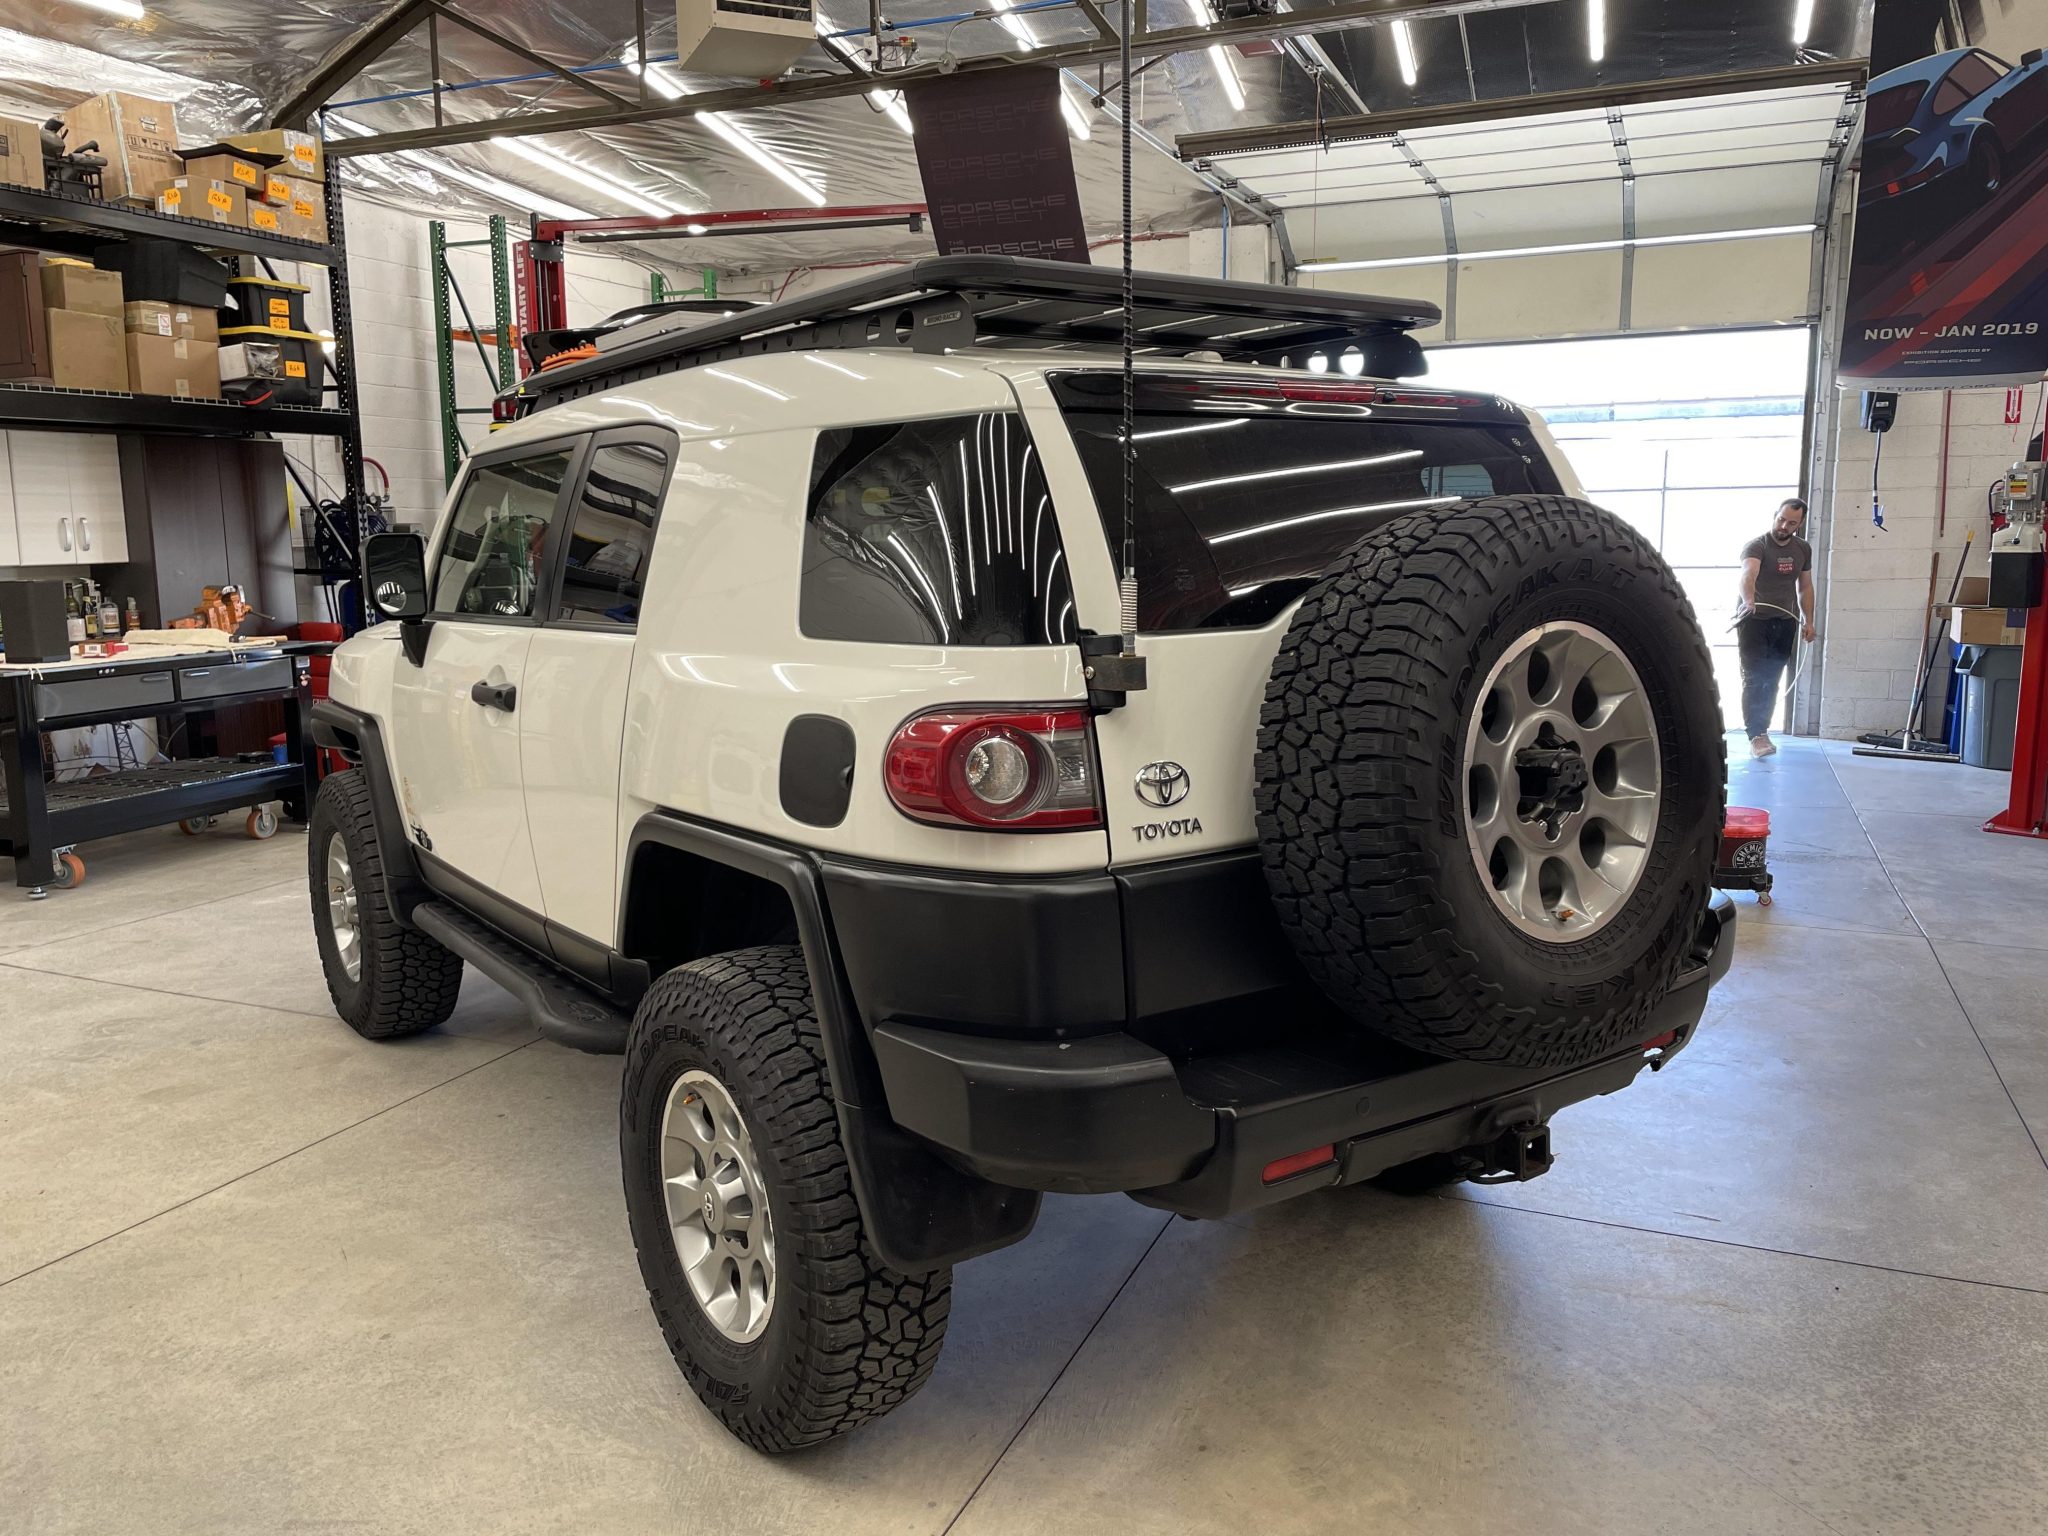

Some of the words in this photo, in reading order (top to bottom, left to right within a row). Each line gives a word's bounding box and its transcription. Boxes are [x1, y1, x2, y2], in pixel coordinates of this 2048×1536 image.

[923, 102, 1049, 124] PORSCHE
[924, 117, 1028, 138] EFFECT
[931, 149, 1057, 170] PORSCHE
[933, 165, 1037, 184] EFFECT
[940, 195, 1067, 216] PORSCHE
[942, 210, 1049, 229] EFFECT
[515, 243, 526, 279] LIFT
[1864, 327, 1914, 340] NOW
[1934, 325, 1976, 338] JAN
[1982, 322, 2039, 336] 2019
[1131, 817, 1203, 843] TOYOTA
